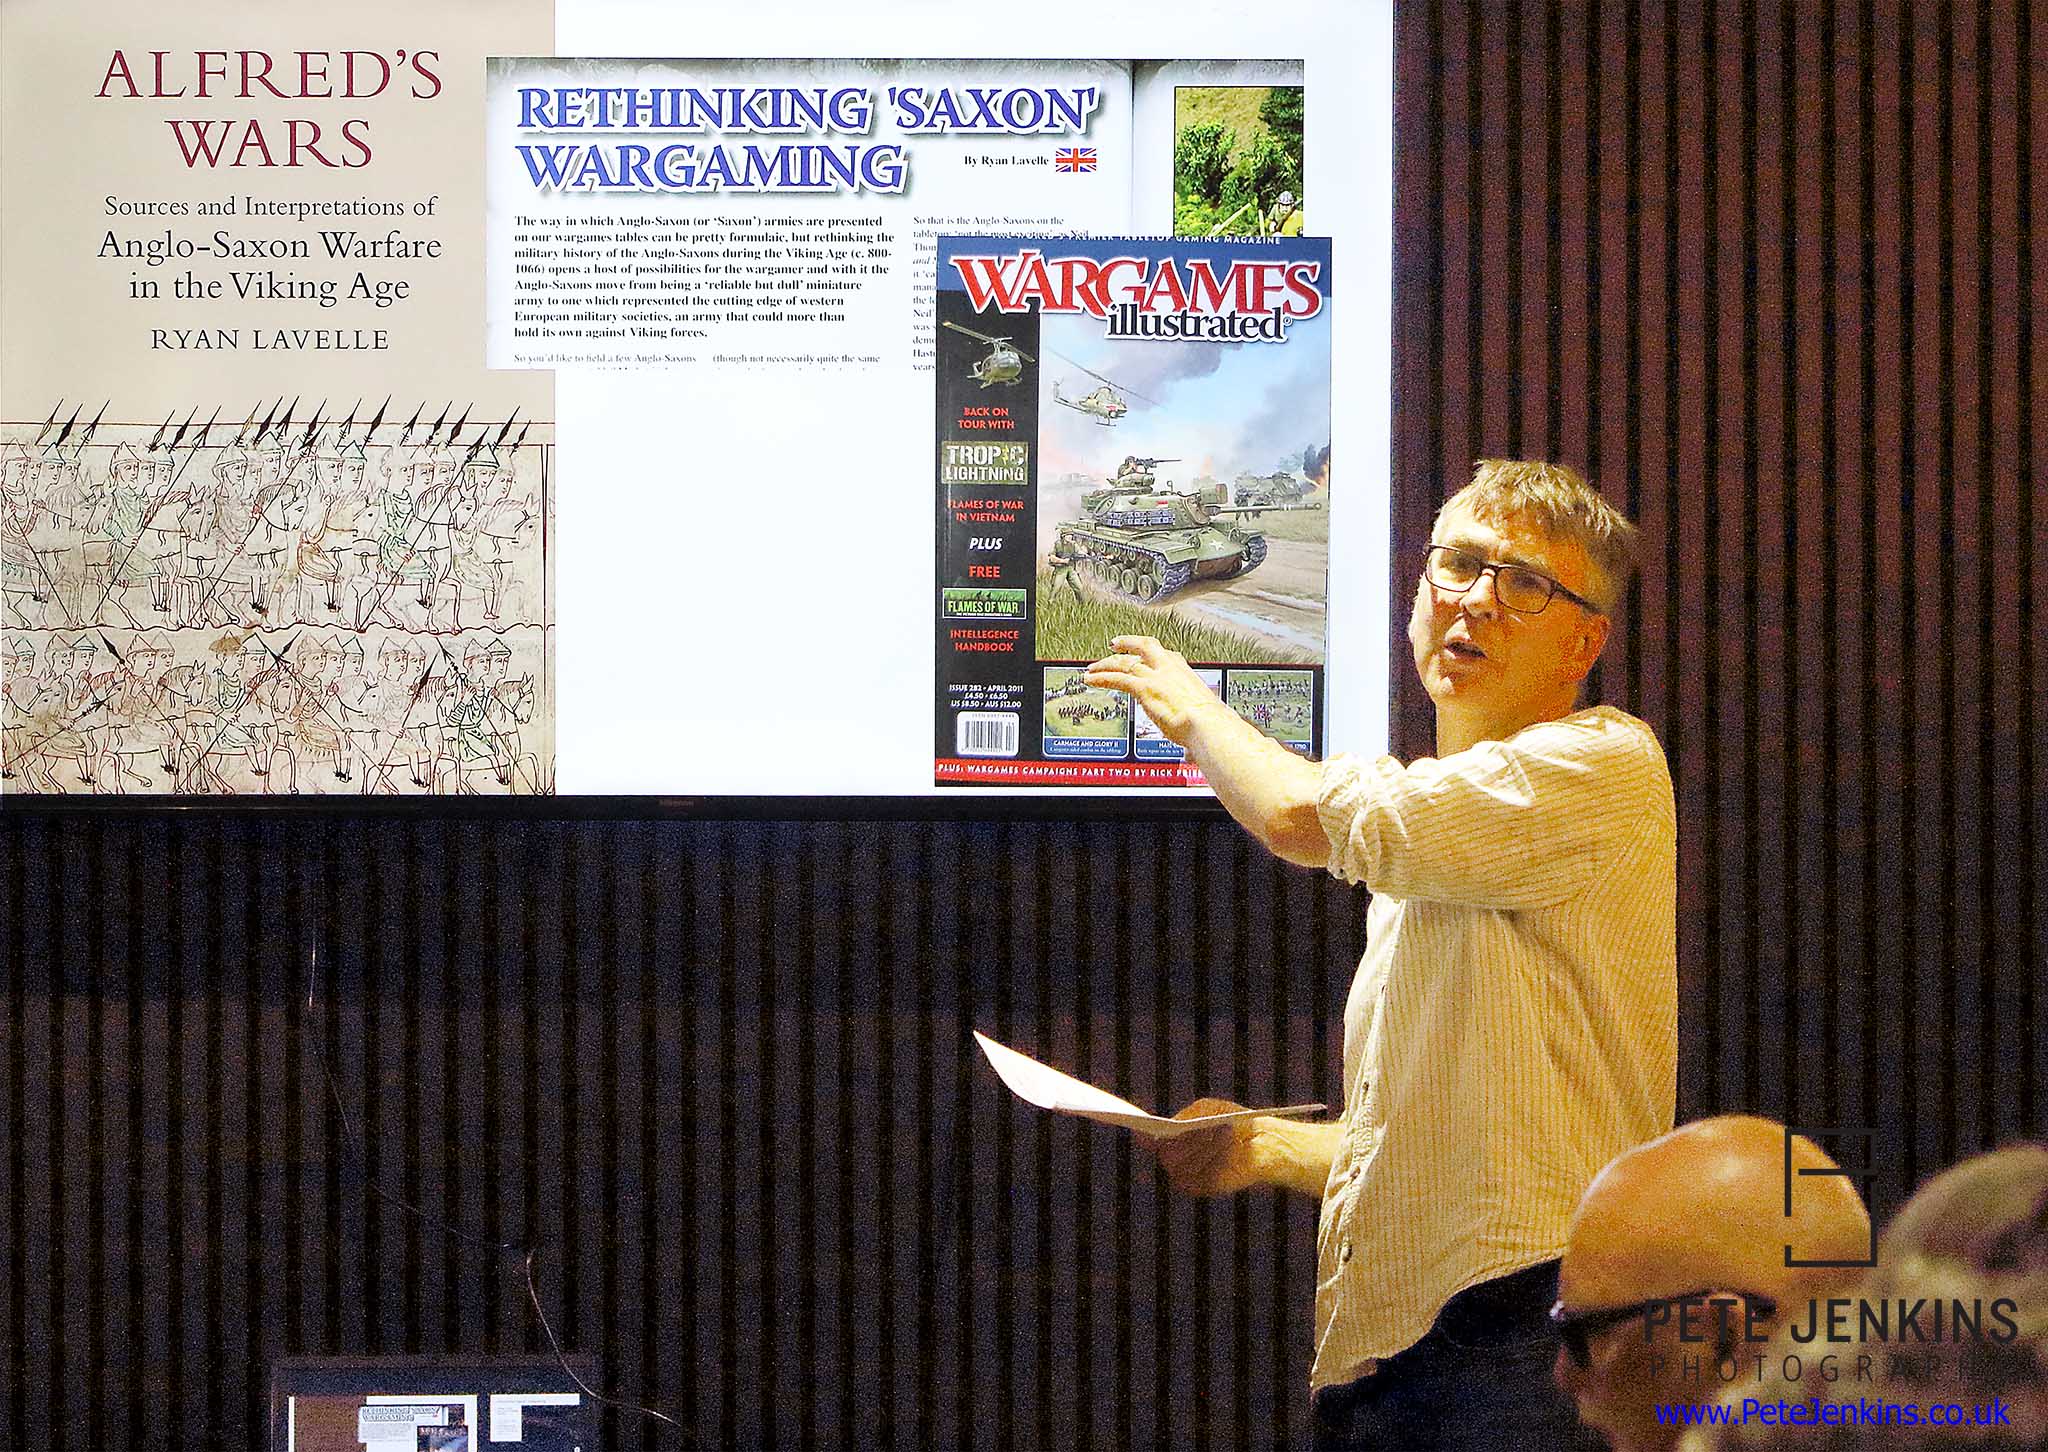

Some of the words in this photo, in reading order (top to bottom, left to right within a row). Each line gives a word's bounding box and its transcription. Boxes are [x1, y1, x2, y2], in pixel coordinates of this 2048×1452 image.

[94, 49, 441, 99] ALFRED'S
[517, 87, 868, 129] RETHINKING
[888, 86, 1095, 129] 'SAXON'
[164, 120, 371, 168] WARS
[515, 144, 903, 188] WARGAMING
[964, 155, 977, 168] By
[981, 155, 1008, 168] Ryan
[1011, 155, 1049, 166] Lavelle
[105, 196, 188, 215] Sources
[198, 196, 236, 215] and
[246, 197, 404, 220] Interpretations
[414, 196, 438, 216] of
[514, 215, 537, 227] The
[540, 218, 561, 229] way
[565, 215, 577, 226] in
[580, 215, 614, 226] which
[616, 215, 690, 228] Anglo-Saxon
[693, 217, 711, 227] (or
[713, 215, 762, 227] 'Saxon')
[764, 215, 804, 227] armies
[806, 218, 825, 227] are
[828, 215, 883, 229] presented
[514, 234, 528, 243] on
[531, 234, 552, 243] our
[554, 234, 613, 245] wargames
[615, 231, 649, 243] tables
[651, 234, 672, 243] can
[675, 231, 689, 243] be
[692, 233, 726, 246] pretty
[729, 231, 789, 243] formulaic,
[791, 231, 810, 243] but
[814, 231, 874, 245] rethinking
[876, 232, 895, 243] the
[1223, 236, 1281, 245] MAGAZINE
[97, 230, 310, 266] Anglo-Saxon
[317, 230, 441, 258] Warfare
[514, 247, 558, 261] military
[563, 247, 601, 261] history
[605, 248, 619, 258] of
[620, 247, 639, 259] the
[641, 247, 720, 260] Anglo-Saxons
[722, 247, 761, 261] during
[764, 247, 783, 259] the
[785, 247, 824, 261] Viking
[825, 248, 848, 261] Age
[850, 249, 865, 259] (c.
[867, 248, 892, 259] 800-
[516, 263, 545, 274] 1066)
[548, 266, 581, 277] opens
[583, 266, 591, 274] a
[594, 263, 617, 274] host
[620, 263, 633, 274] of
[635, 263, 702, 277] possibilities
[704, 263, 722, 274] for
[724, 263, 743, 275] the
[745, 266, 804, 277] wargamer
[806, 263, 828, 275] and
[831, 263, 857, 275] with
[859, 263, 868, 275] it
[871, 264, 889, 275] the
[130, 272, 160, 298] in
[174, 271, 222, 298] the
[229, 271, 337, 307] Viking
[347, 273, 409, 308] Age
[514, 279, 593, 292] Anglo-Saxons
[595, 282, 626, 290] move
[629, 279, 657, 290] from
[660, 279, 692, 292] being
[694, 282, 701, 290] a
[704, 279, 752, 290] 'reliable
[754, 279, 774, 290] but
[777, 279, 804, 290] dull'
[806, 279, 862, 290] miniature
[952, 251, 1320, 317] WARGAMES
[514, 298, 544, 309] army
[547, 296, 559, 306] to
[561, 298, 582, 306] one
[585, 295, 619, 306] which
[622, 295, 689, 309] represented
[692, 295, 711, 306] the
[713, 295, 754, 308] cutting
[756, 295, 783, 308] edge
[785, 295, 798, 306] of
[800, 296, 844, 306] western
[514, 311, 570, 324] European
[573, 311, 617, 324] military
[621, 311, 672, 322] societies,
[674, 313, 689, 322] an
[692, 313, 721, 324] army
[726, 311, 749, 322] that
[752, 311, 783, 322] could
[786, 313, 817, 322] more
[819, 311, 845, 322] than
[1108, 304, 1283, 340] illustrated
[152, 330, 239, 349] RYAN
[253, 330, 388, 349] LAVELLE
[514, 327, 539, 338] hold
[542, 327, 556, 337] its
[558, 329, 582, 338] own
[585, 327, 626, 340] against
[629, 327, 668, 340] Viking
[670, 327, 708, 338] forces.
[963, 407, 990, 417] BACK
[992, 407, 1009, 417] ON
[958, 419, 986, 429] TOUR
[988, 420, 1015, 430] WITH
[945, 466, 1025, 481] LIGHTNING
[947, 499, 984, 509] FLAMES
[986, 500, 1000, 509] OF
[1001, 500, 1025, 510] WAR
[956, 512, 968, 522] IN
[969, 512, 1016, 523] VIETNAM
[969, 537, 1003, 550] PLUS
[968, 565, 1001, 578] FREE
[947, 600, 984, 613] FLAMES
[984, 601, 996, 613] OF
[997, 601, 1019, 614] WAR
[950, 629, 1020, 640] INTELLEGENCE
[955, 641, 1015, 652] HANDBOOK
[949, 684, 968, 692] ISSUE
[987, 685, 1007, 693] APRIL
[967, 765, 1019, 775] WARGAMES
[1022, 766, 1078, 776] CAMPAIGNS
[1082, 768, 1105, 776] PART
[1108, 768, 1131, 777] TWO
[1135, 769, 1146, 777] BY
[1150, 769, 1173, 777] RICK
